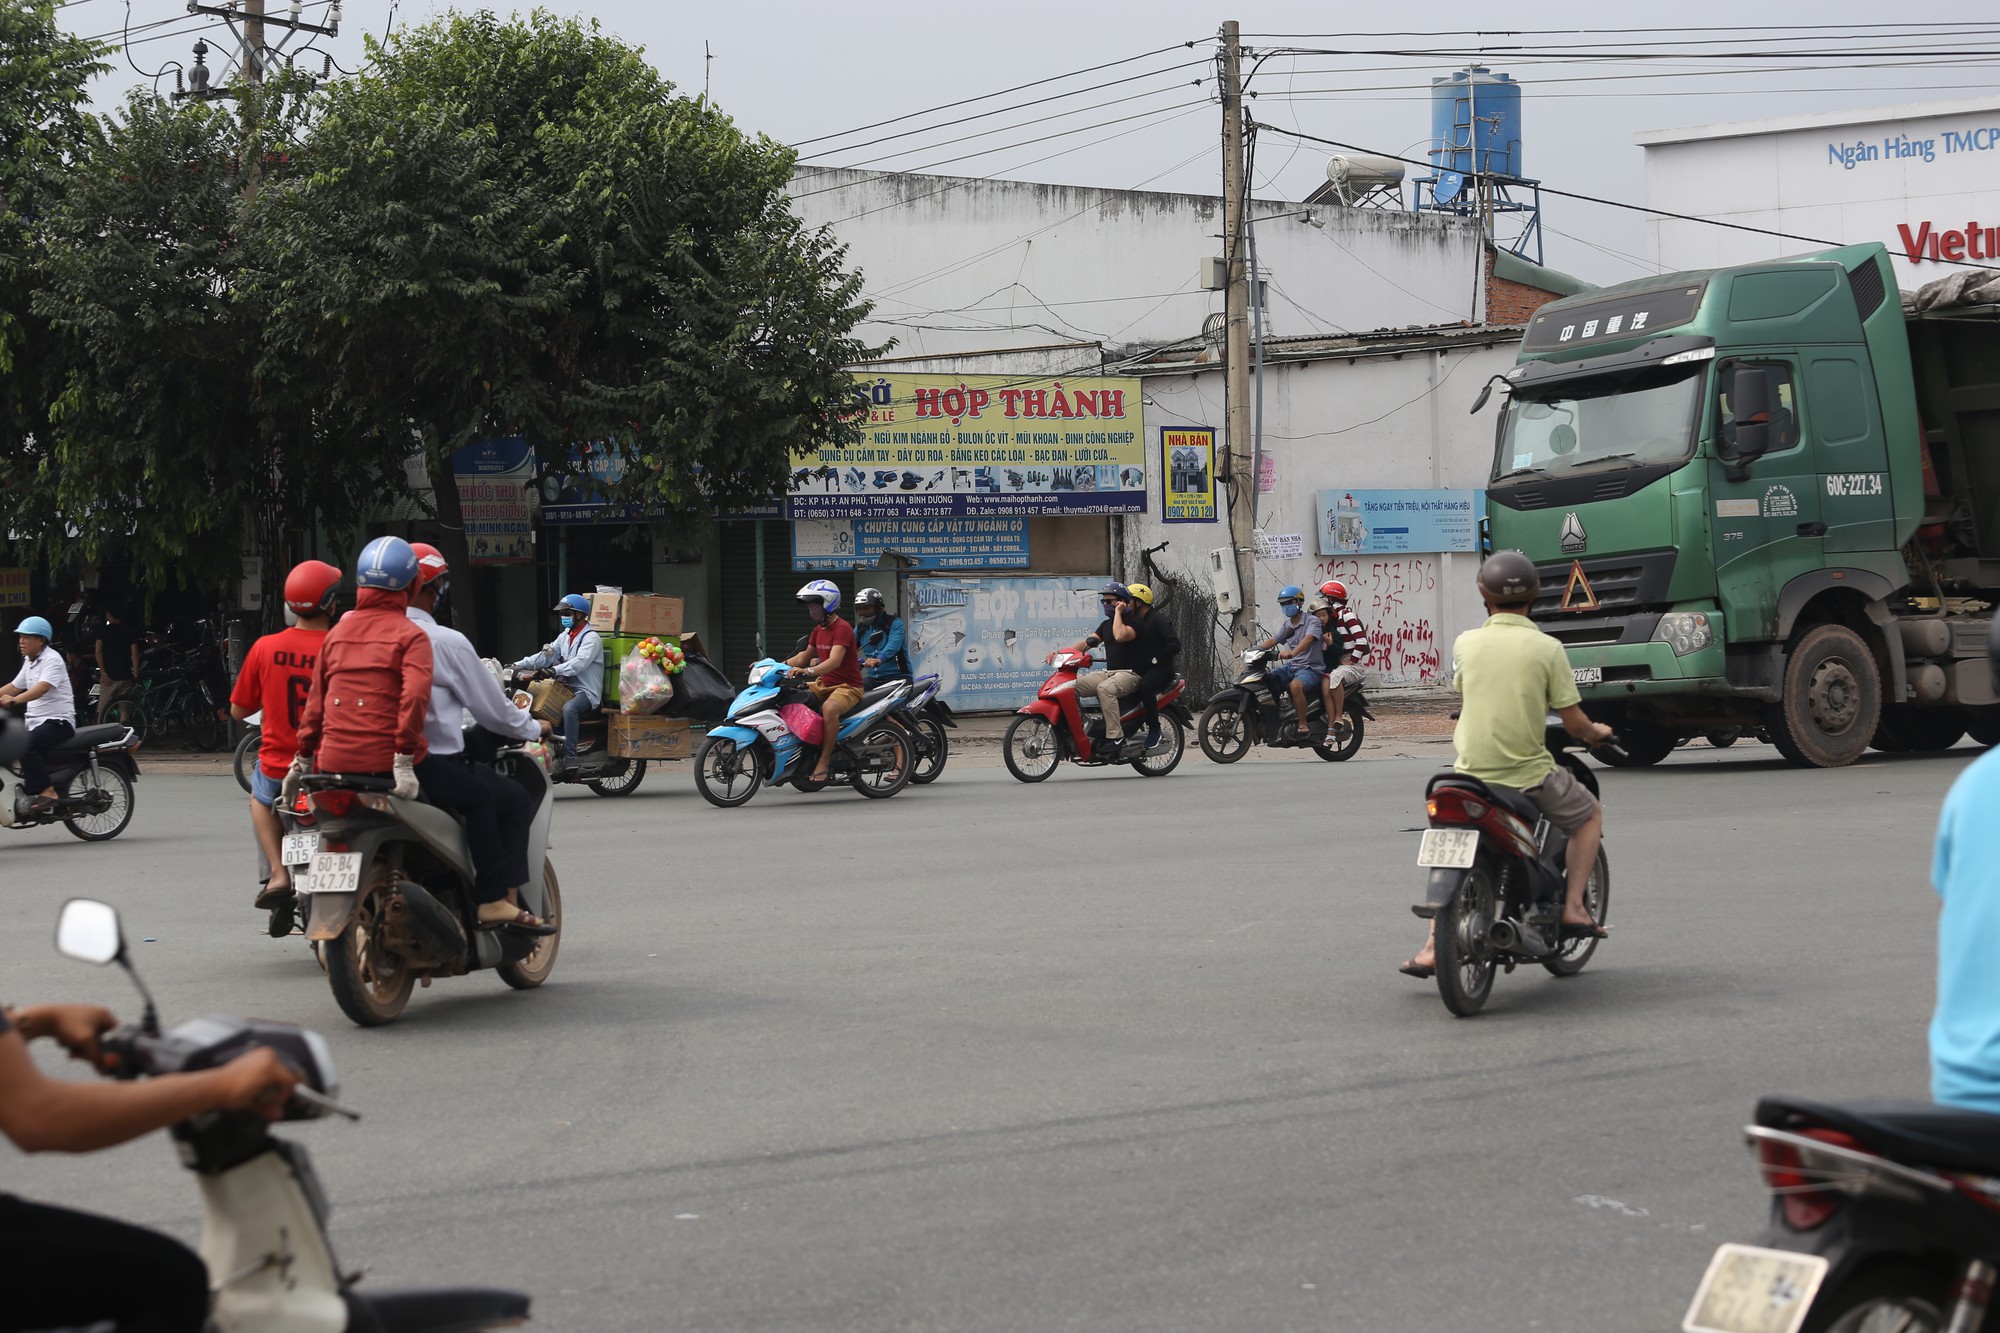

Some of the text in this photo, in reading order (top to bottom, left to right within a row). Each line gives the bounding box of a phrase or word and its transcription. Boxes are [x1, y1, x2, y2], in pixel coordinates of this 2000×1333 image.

[1828, 127, 2000, 170] Ngân Hàng TMCP
[1559, 311, 1649, 342] 中国重汽
[914, 382, 1125, 426] HỢP THÀNH
[874, 430, 891, 444] NGŨ
[893, 432, 908, 444] KIM
[910, 430, 938, 444] NGÀNH
[958, 432, 983, 444] BULON
[1033, 432, 1059, 444] KHOAN
[1085, 430, 1106, 444] CÔNG
[1107, 430, 1135, 446] NGHIỆP
[1168, 432, 1208, 446] NHÀ BÁN
[819, 450, 841, 465] DỤNG
[877, 449, 890, 462] TAY
[897, 448, 913, 462] DÂY
[928, 450, 944, 461] ROA
[974, 450, 989, 462] KEO
[991, 448, 1007, 462] CÁC
[1034, 450, 1051, 464] BẠC
[1826, 474, 1883, 496] 60C-227.34
[808, 497, 820, 505] KP
[821, 496, 830, 505] 1A
[839, 496, 849, 505] AN
[869, 494, 894, 506] THUẬN
[909, 493, 926, 504] BÌNH
[927, 494, 953, 504] DƯƠNG
[966, 495, 1059, 504] Web: www.maihopthanh.com
[1364, 501, 1378, 514] TẶNG
[1379, 502, 1393, 511] NGAY
[794, 509, 807, 517] ĐT:
[807, 508, 829, 519] (0650)
[836, 508, 848, 516] 711
[849, 508, 862, 516] 648
[867, 508, 872, 516] 3
[873, 508, 885, 516] 777
[886, 508, 899, 516] 063
[906, 507, 922, 516] FAX:
[923, 507, 937, 516] 3712
[938, 507, 952, 515] 877
[979, 506, 996, 515] Zalo:
[997, 506, 1012, 515] 0908
[1013, 506, 1026, 514] 913
[1027, 506, 1039, 514] 457
[1042, 506, 1062, 514] Email:
[1167, 505, 1213, 517] 0902 120 120
[864, 519, 899, 534] CHUYÊN
[901, 520, 926, 533] CUNG
[927, 517, 945, 533] CẤP
[946, 518, 963, 536] VẬT
[977, 517, 1008, 532] NGÀNH
[1723, 532, 1744, 541] 375
[317, 854, 353, 872] 60-B4
[1427, 849, 1466, 865] 3874
[310, 873, 356, 890] 347.78
